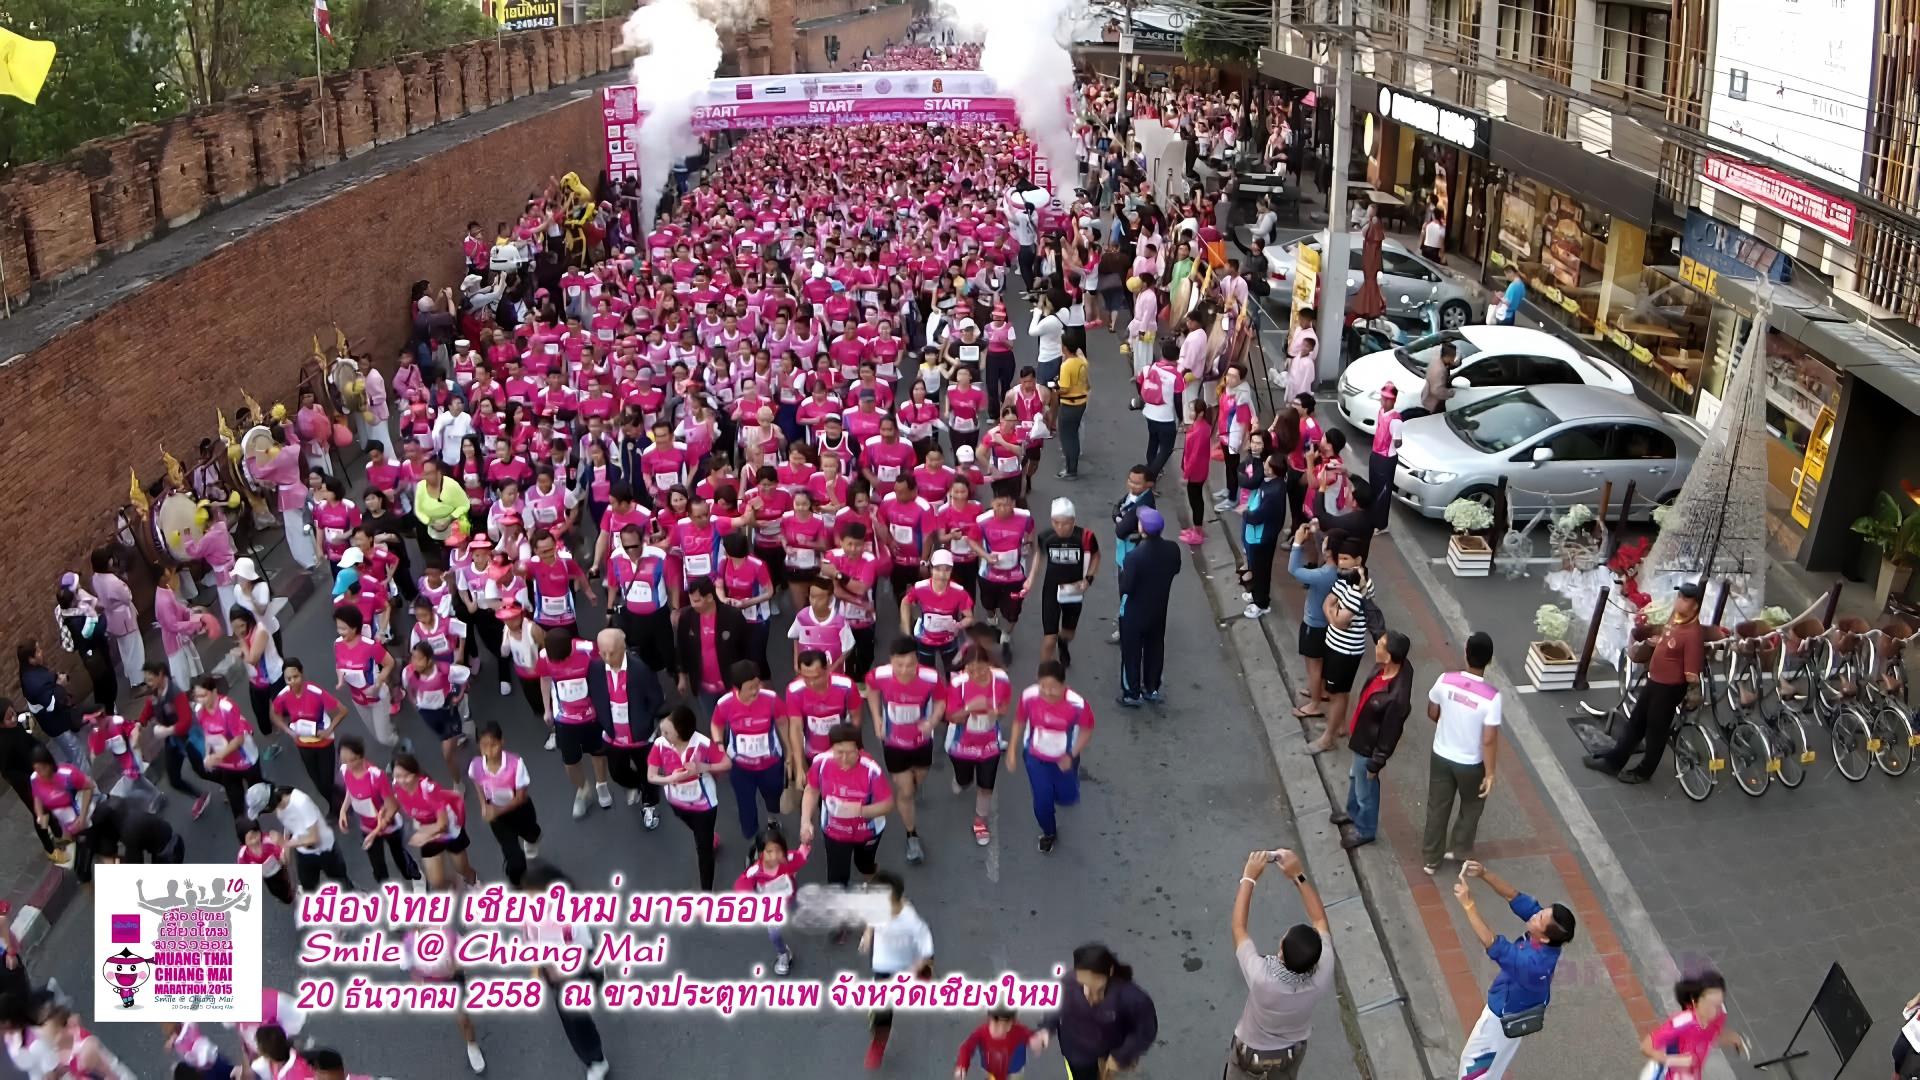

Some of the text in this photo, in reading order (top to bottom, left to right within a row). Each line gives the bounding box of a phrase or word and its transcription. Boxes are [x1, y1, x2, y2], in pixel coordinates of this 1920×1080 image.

[808, 100, 856, 113] START
[923, 99, 971, 111] START
[695, 106, 740, 118] START
